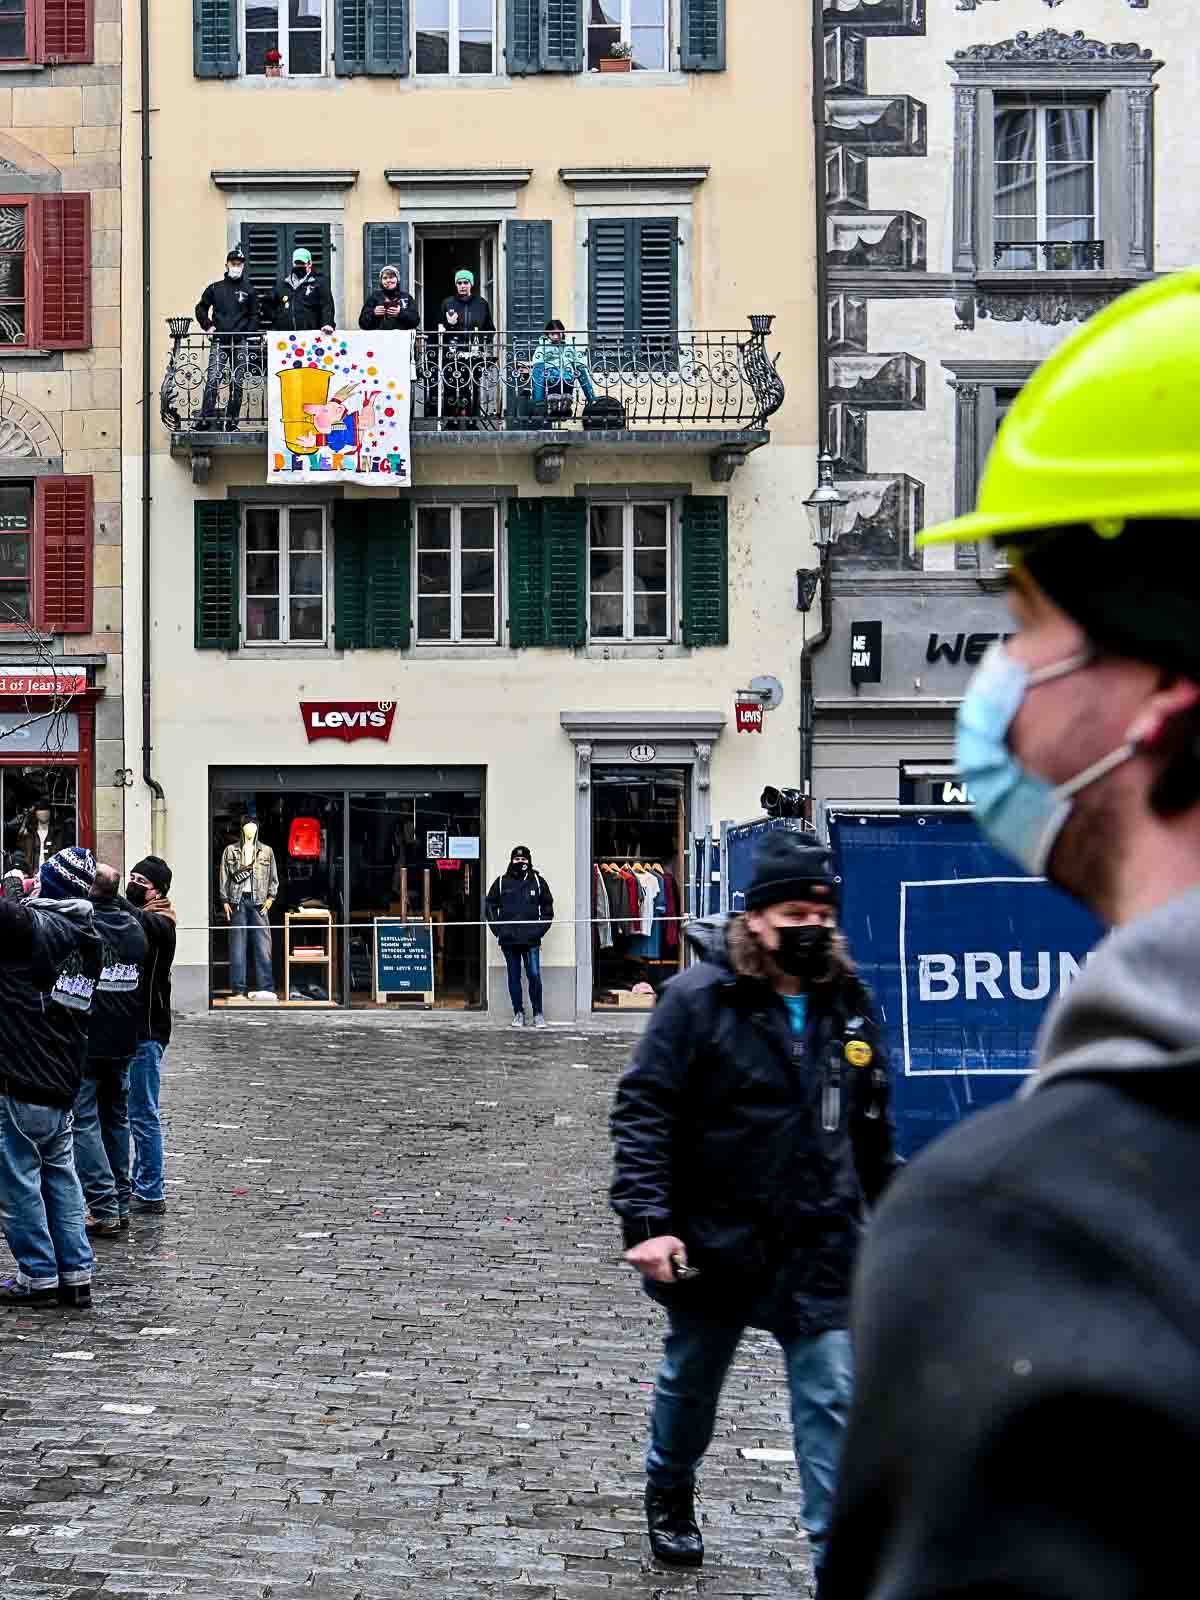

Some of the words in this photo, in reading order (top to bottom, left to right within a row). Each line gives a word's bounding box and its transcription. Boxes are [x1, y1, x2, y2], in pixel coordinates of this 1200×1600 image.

[853, 635, 866, 650] WE
[926, 633, 1016, 665] WE
[852, 652, 870, 667] RUN
[10, 679, 24, 691] of
[26, 679, 62, 694] Jeans
[942, 781, 968, 802] W
